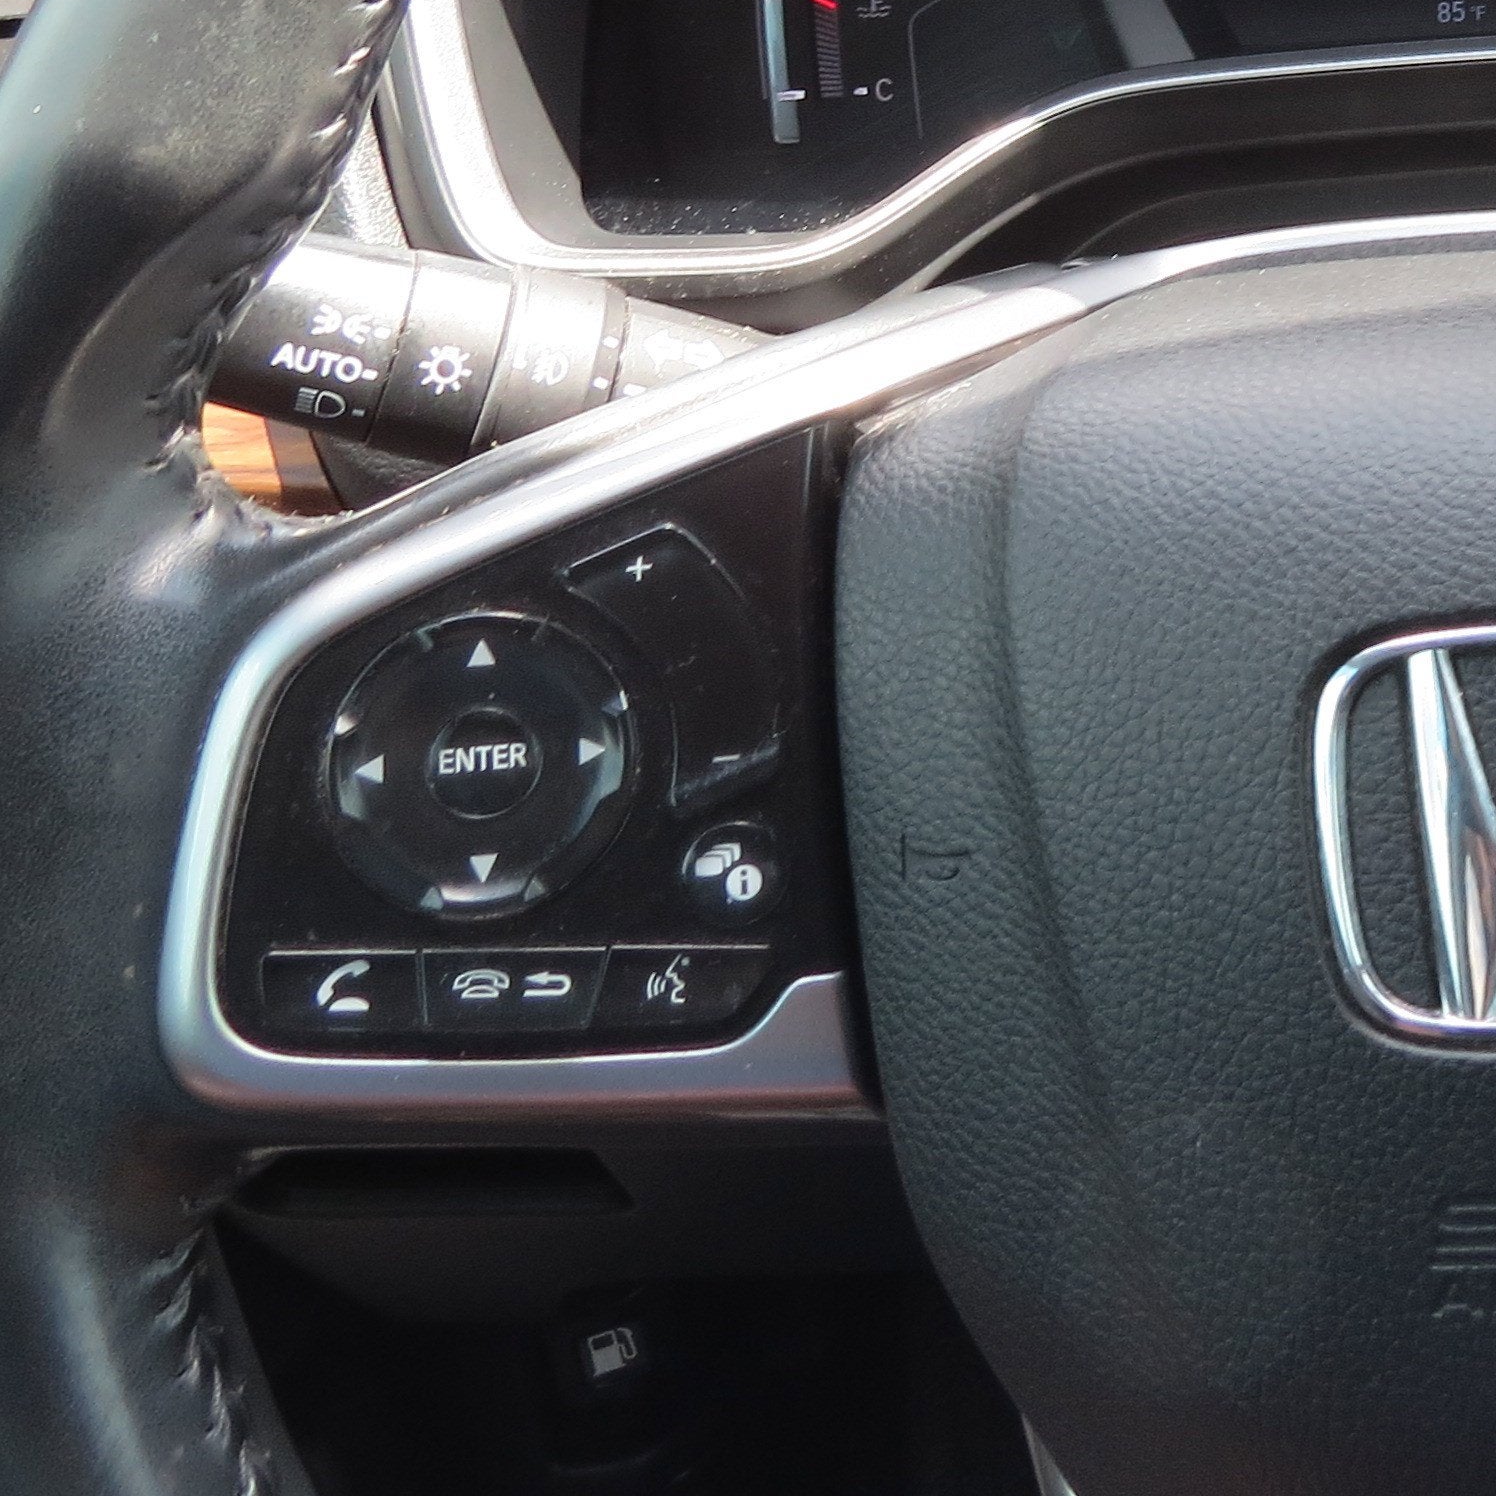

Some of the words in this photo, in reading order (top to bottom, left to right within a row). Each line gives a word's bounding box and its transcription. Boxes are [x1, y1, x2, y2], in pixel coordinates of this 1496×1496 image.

[1436, 0, 1466, 23] 85
[875, 78, 894, 102] C
[270, 341, 362, 384] AUTO
[438, 742, 528, 775] ENTER
